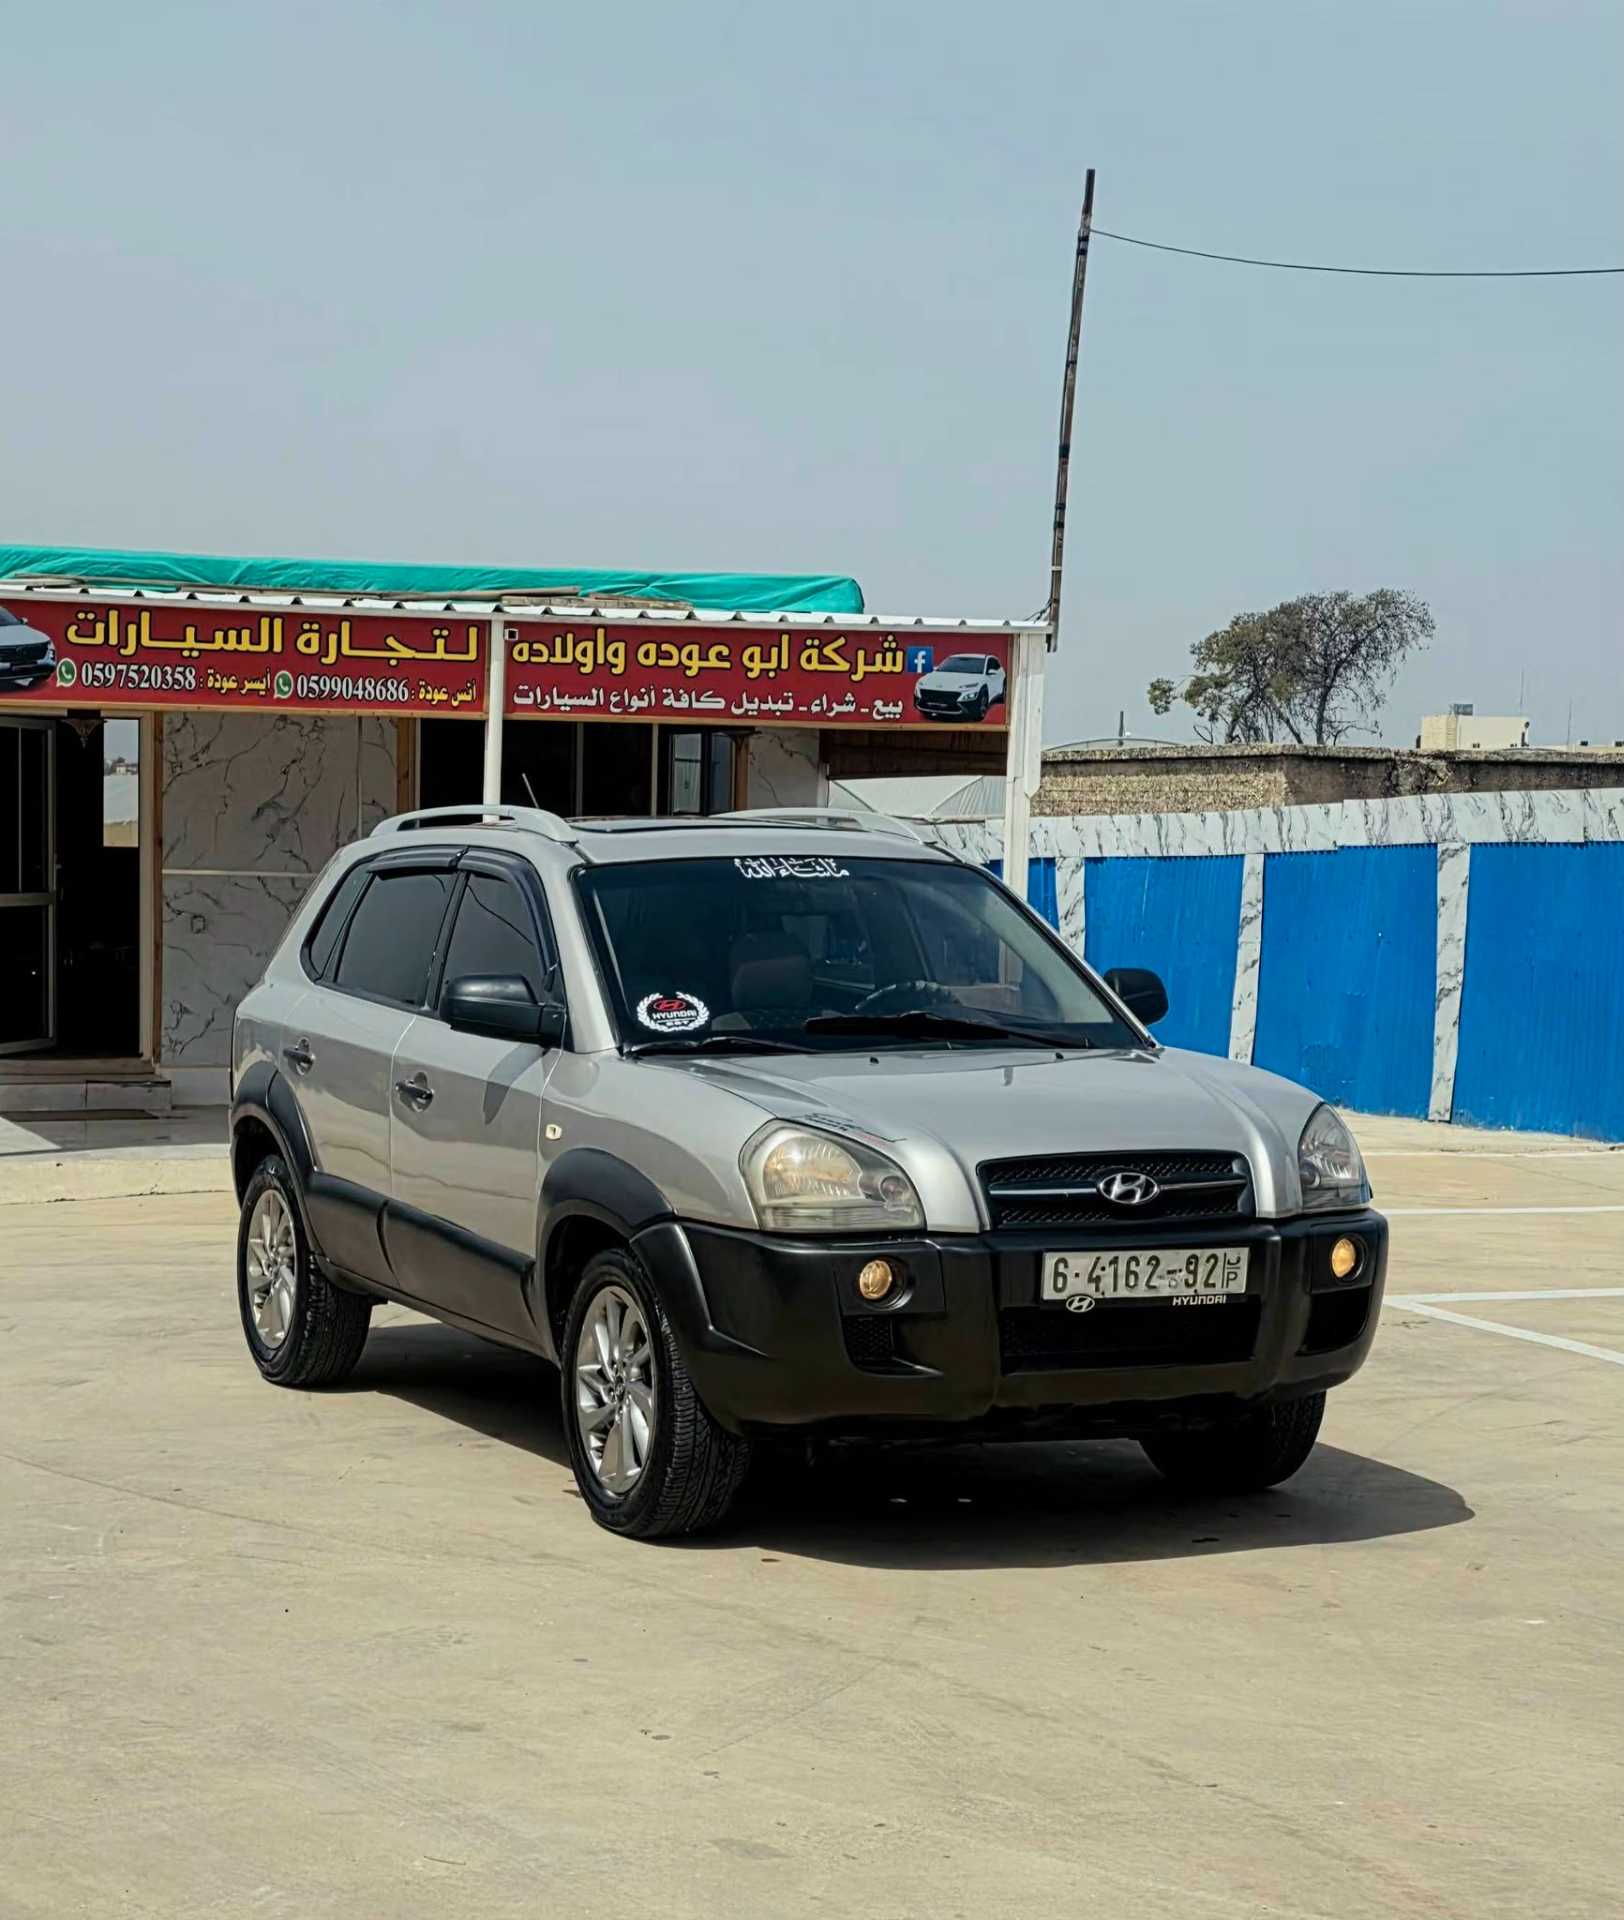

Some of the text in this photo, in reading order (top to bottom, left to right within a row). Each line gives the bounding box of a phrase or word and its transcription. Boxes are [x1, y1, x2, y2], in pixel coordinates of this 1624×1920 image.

[66, 609, 478, 667] لتجارة السيارات
[636, 642, 731, 677] عوده
[742, 634, 790, 679] ابو
[799, 634, 904, 682] شركة
[80, 661, 197, 690] 0597520358
[207, 668, 238, 694] عودة
[296, 673, 409, 702] 0599048686
[418, 680, 449, 705] عودة
[513, 685, 605, 712] السيارات
[609, 685, 657, 713] أنواع
[662, 688, 726, 710] كافة
[731, 690, 794, 717] تبديل
[810, 692, 857, 718] شراء
[872, 698, 904, 720] بيع
[652, 1009, 698, 1020] HYUNDAI
[1226, 1271, 1239, 1288] P
[1172, 1294, 1227, 1307] HYUNDAI
